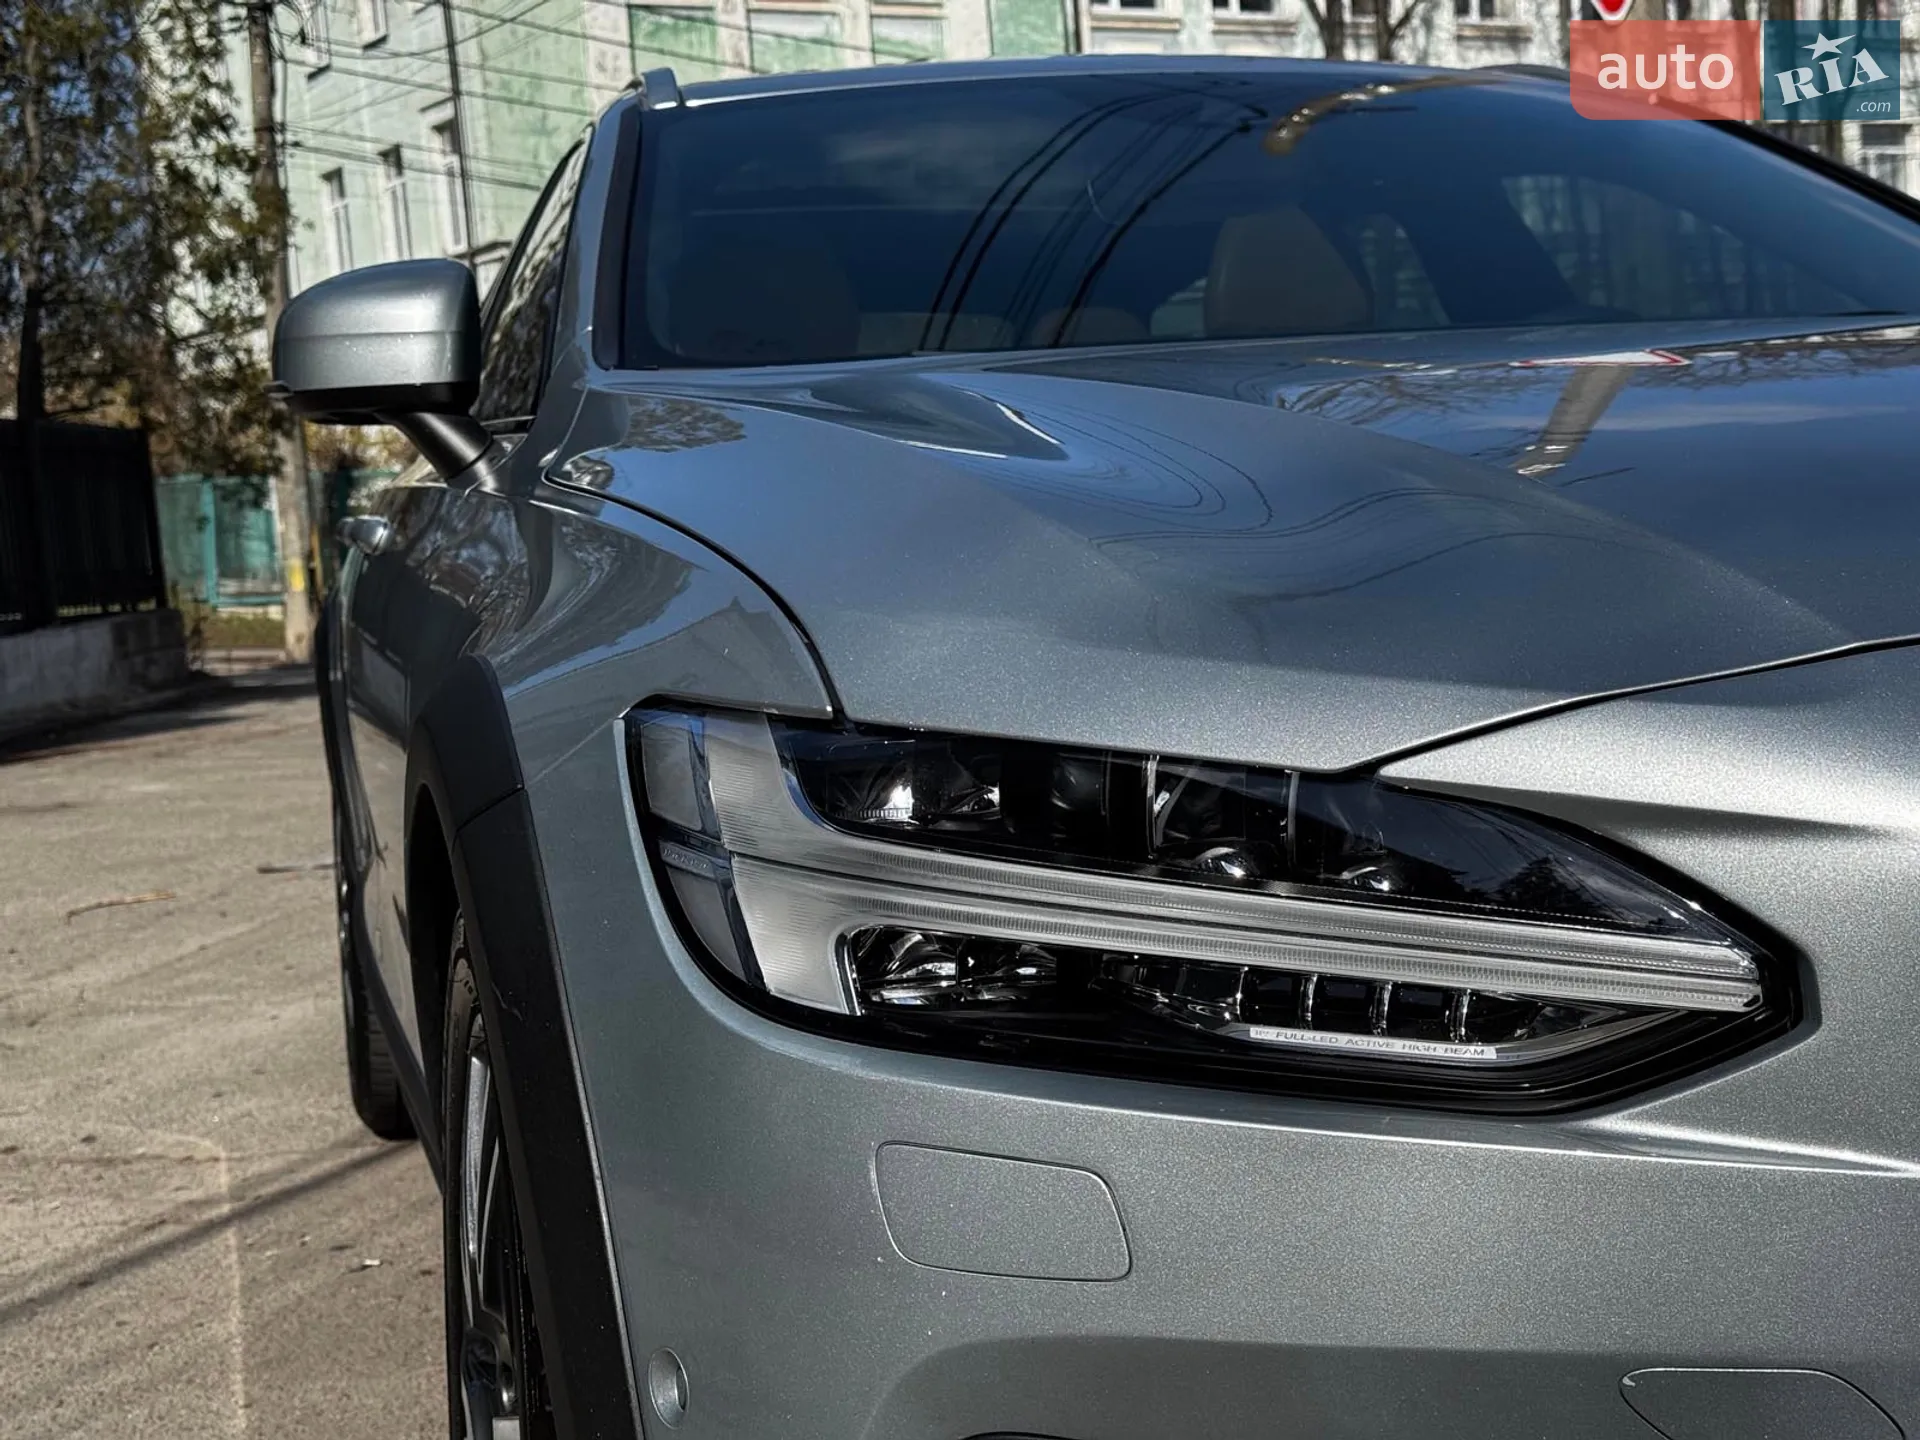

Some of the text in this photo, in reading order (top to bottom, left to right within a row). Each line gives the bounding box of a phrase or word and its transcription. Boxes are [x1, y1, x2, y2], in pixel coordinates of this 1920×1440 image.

[1344, 1038, 1395, 1049] ACTIVE
[1401, 1043, 1438, 1053] HIGH
[1443, 1047, 1485, 1057] BEAM
